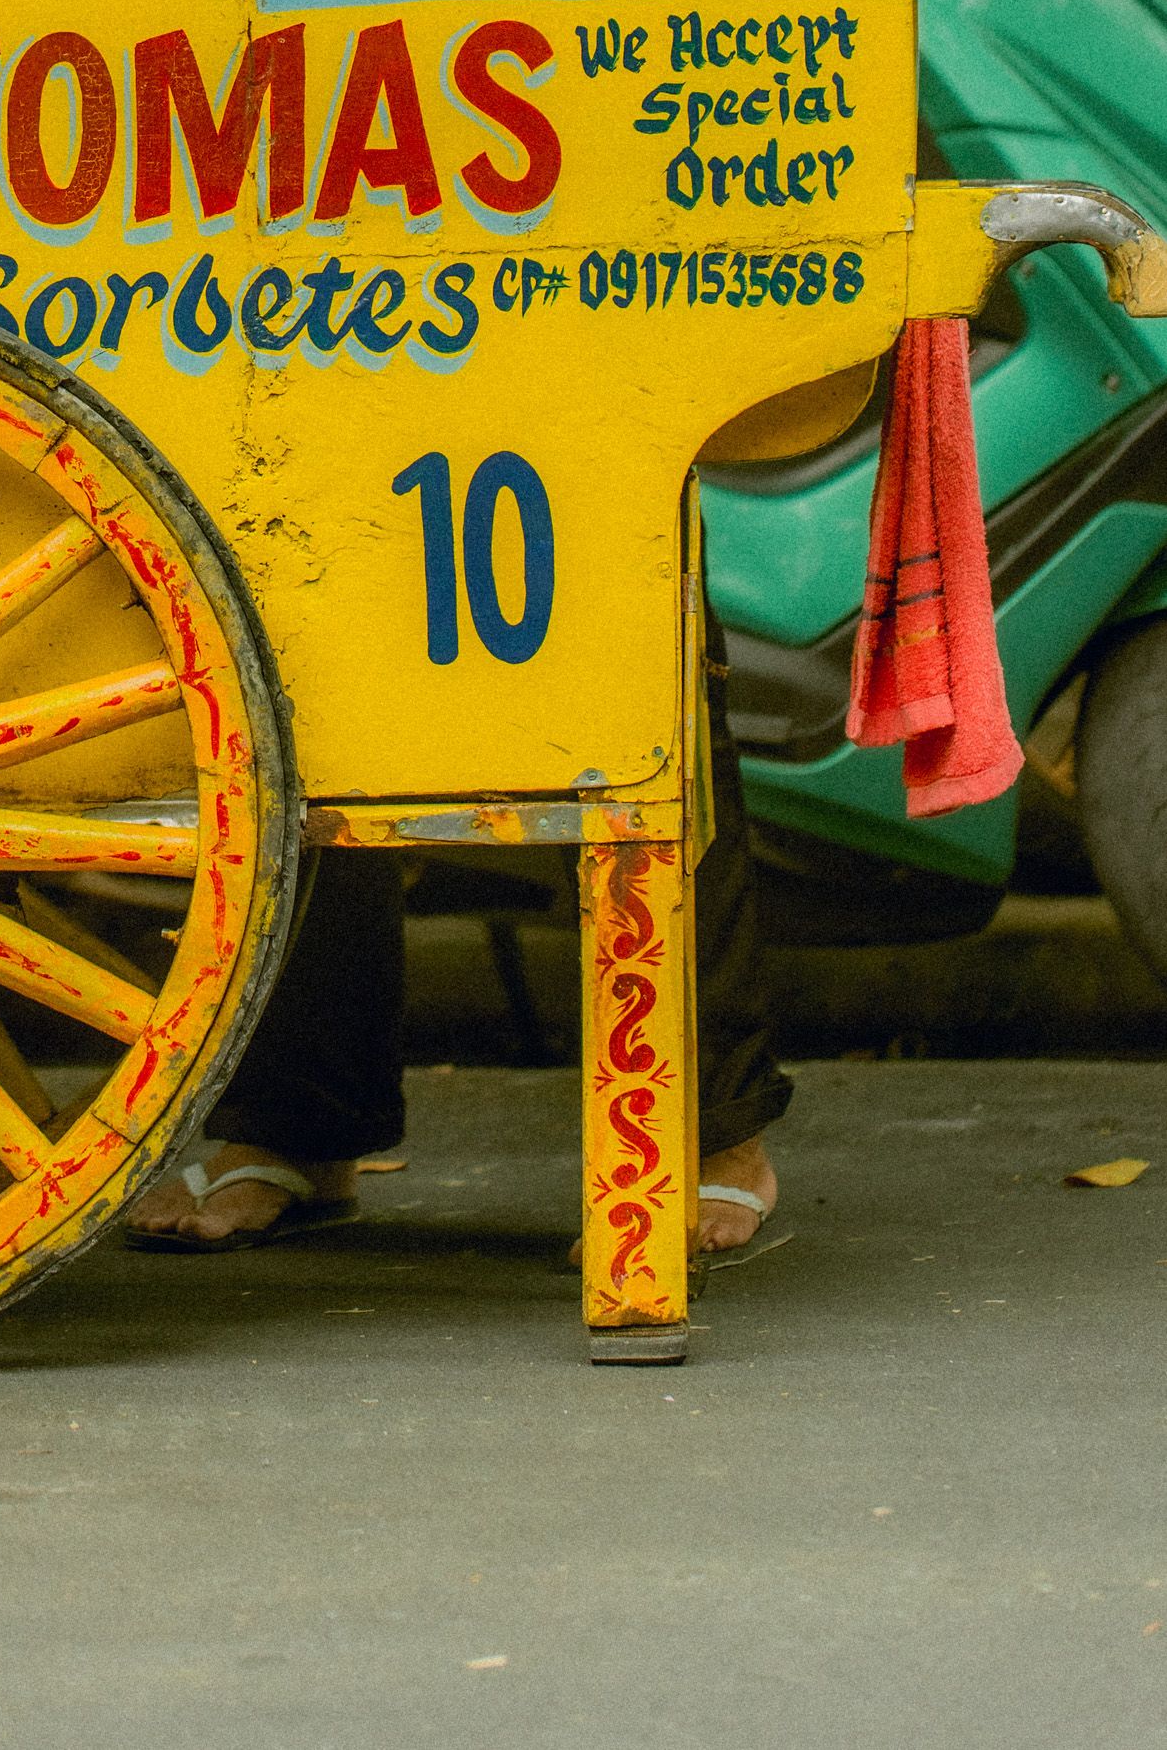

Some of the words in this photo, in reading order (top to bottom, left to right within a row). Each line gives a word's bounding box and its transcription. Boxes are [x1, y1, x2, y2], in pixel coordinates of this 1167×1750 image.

[575, 18, 648, 78] We
[668, 7, 859, 77] Accept
[632, 72, 856, 147] Special
[663, 138, 855, 210] Order
[579, 250, 866, 313] 09171535688
[391, 450, 556, 666] 10
